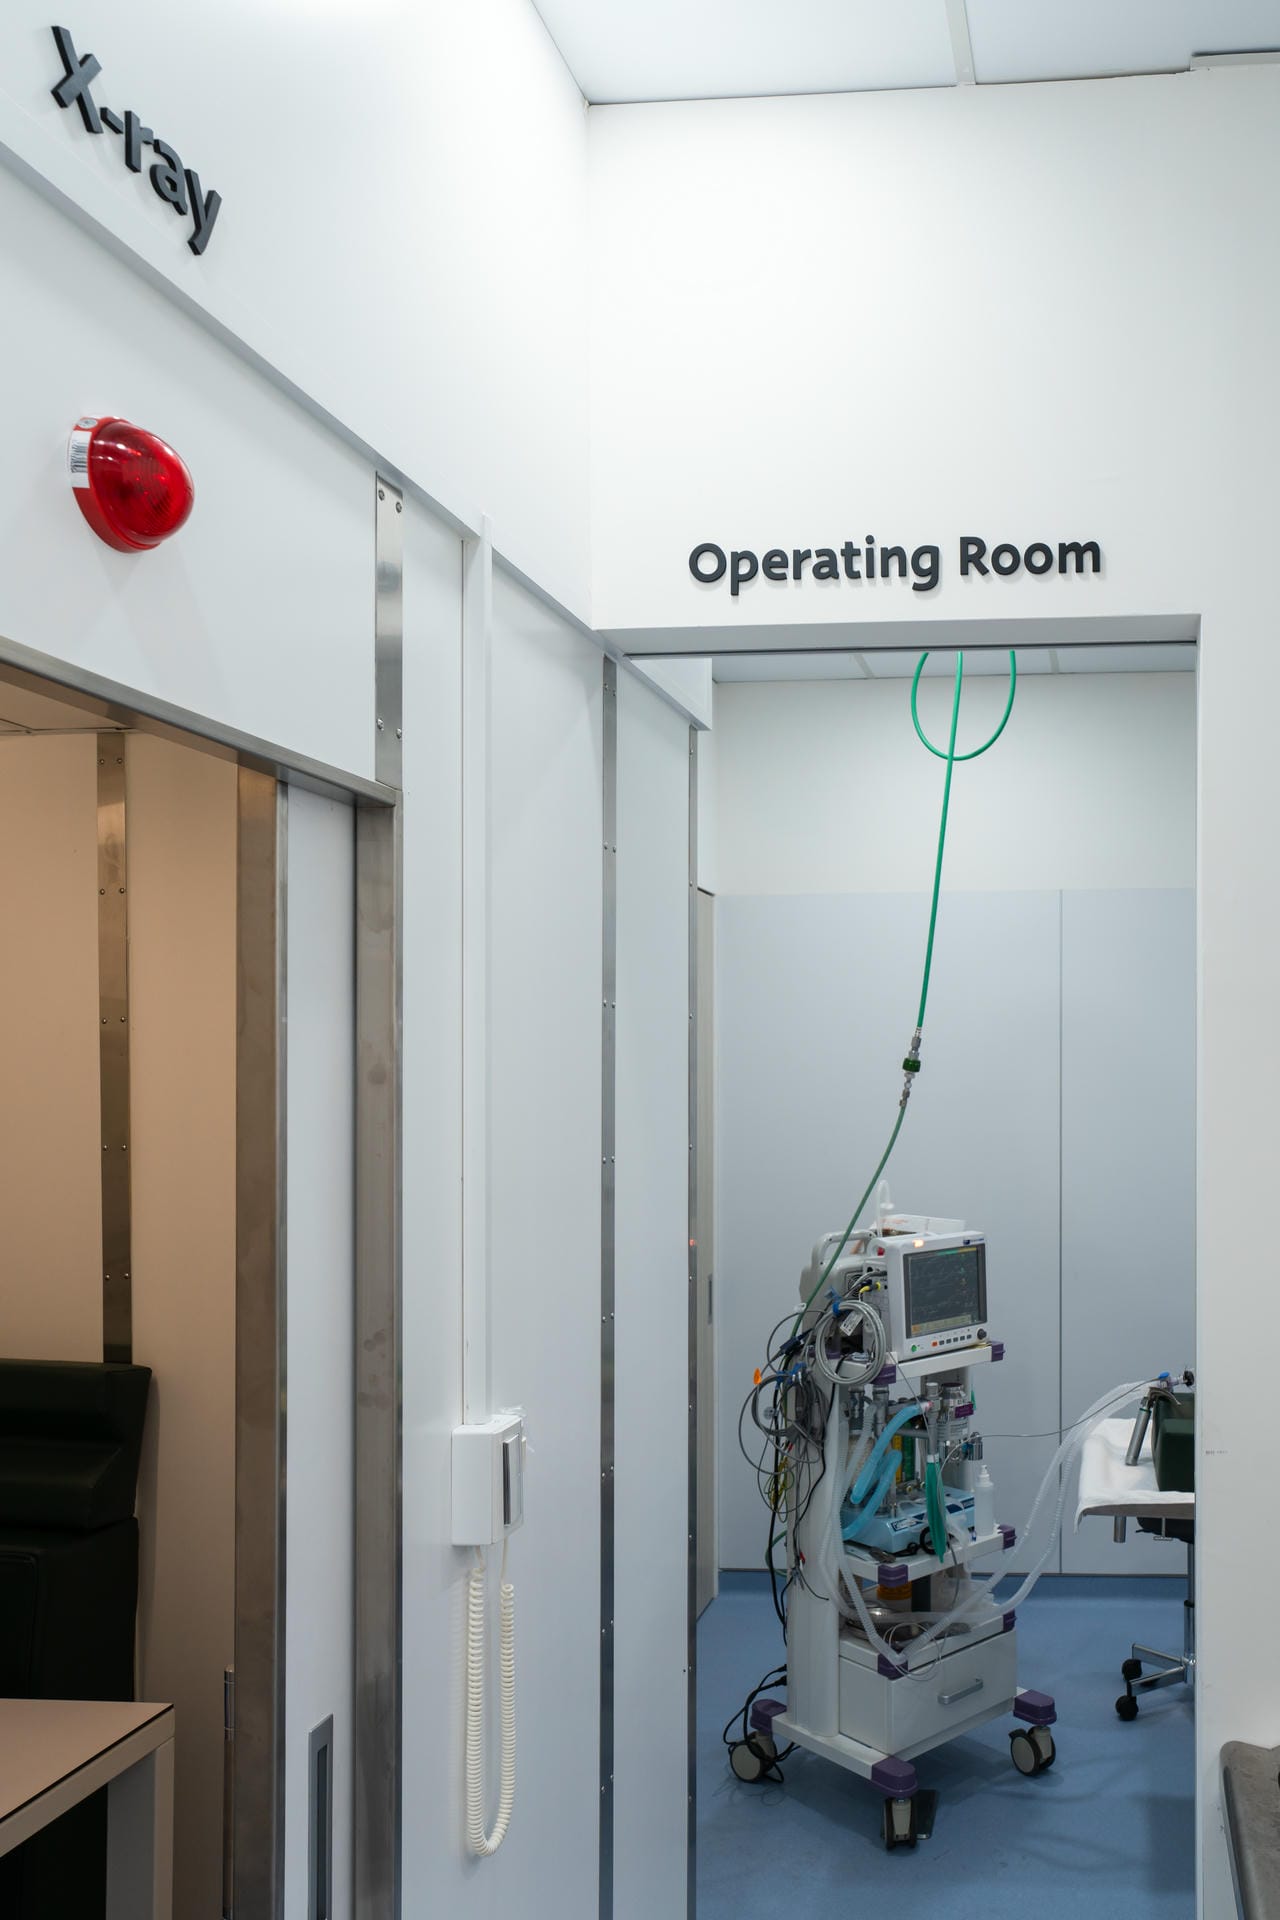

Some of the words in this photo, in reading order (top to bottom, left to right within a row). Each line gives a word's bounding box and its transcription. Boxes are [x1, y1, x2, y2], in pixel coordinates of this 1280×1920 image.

[51, 26, 222, 255] X-ray
[688, 534, 940, 595] Operating
[959, 536, 1101, 575] Room
